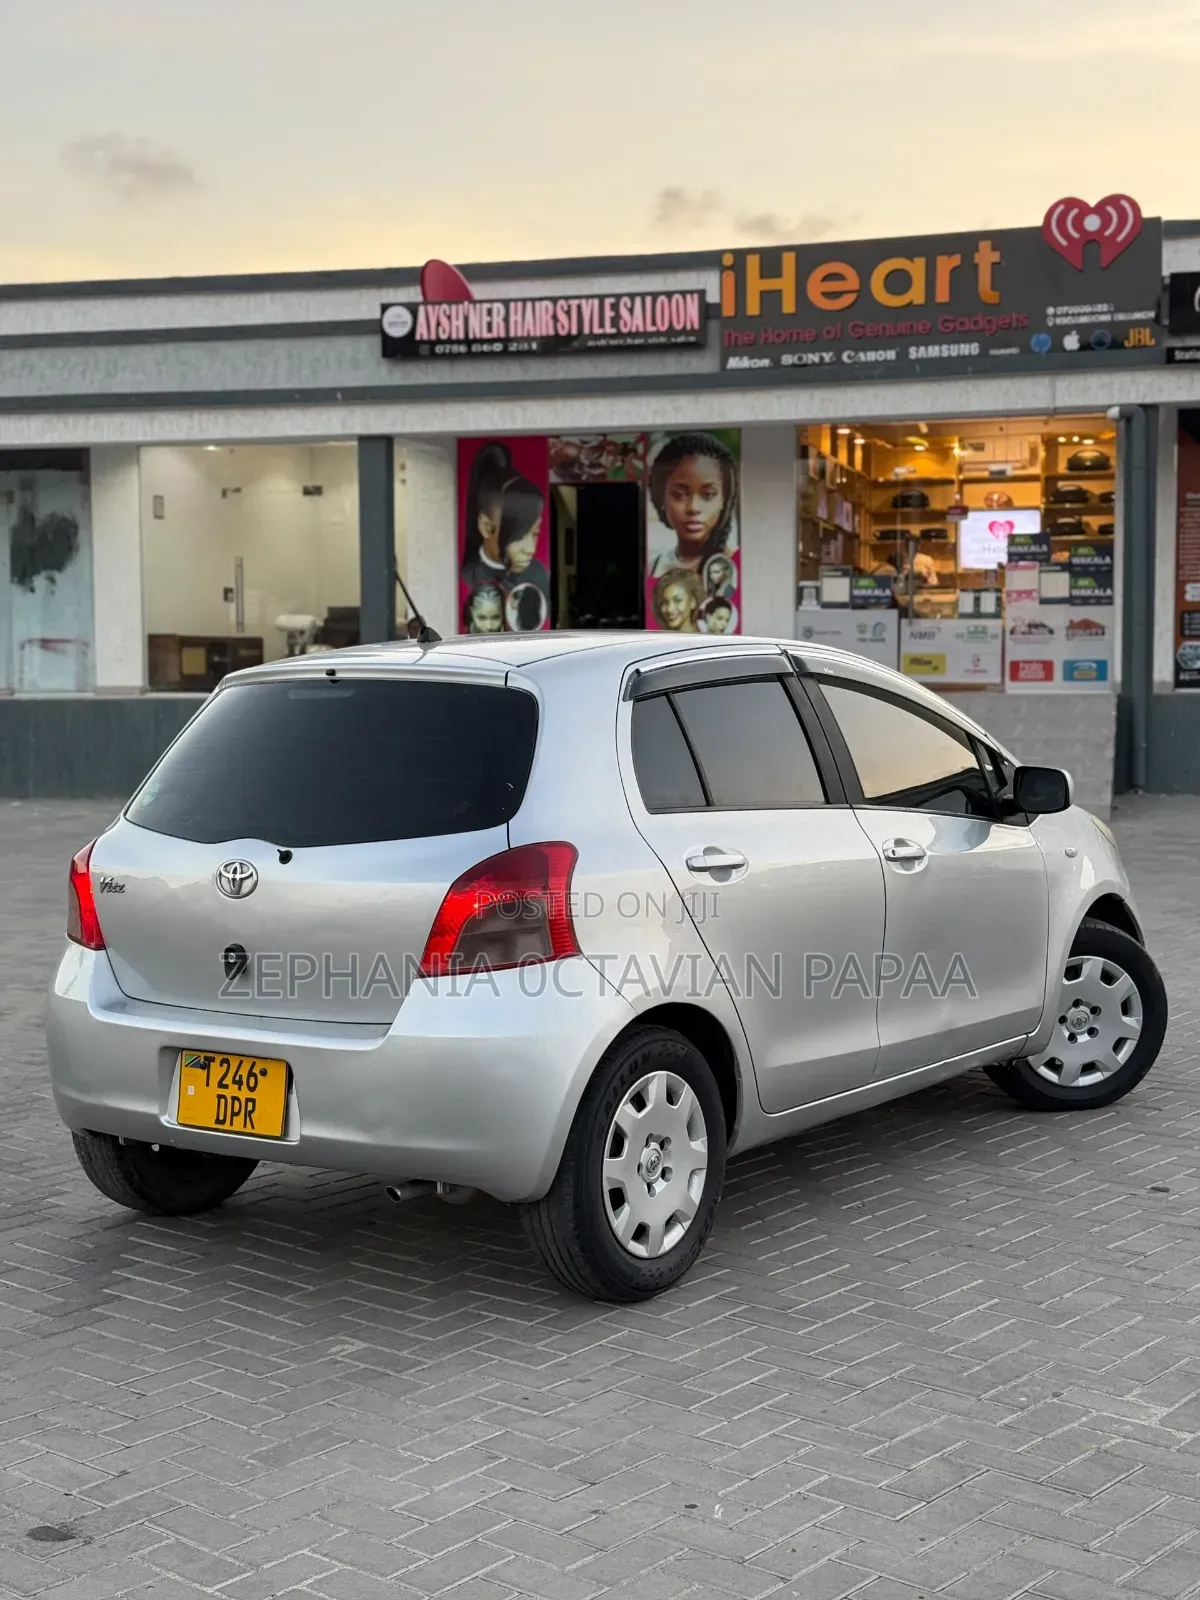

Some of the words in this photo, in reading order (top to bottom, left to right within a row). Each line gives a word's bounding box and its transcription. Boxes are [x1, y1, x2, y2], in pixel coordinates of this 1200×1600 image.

[722, 240, 1000, 317] iHeart
[415, 301, 506, 340] AYSH'NER
[509, 301, 555, 337] HAIR
[556, 298, 617, 336] STYLE
[619, 293, 699, 334] SALOON
[723, 329, 756, 348] The
[760, 327, 818, 344] Home
[849, 319, 931, 338] Genuine
[938, 312, 1029, 334] Gadgets
[1123, 327, 1156, 348] JBL
[780, 351, 834, 365] SONY
[908, 342, 980, 360] SAMSUNG
[726, 355, 771, 369] Nikon
[1071, 555, 1112, 565] WAKALA
[1071, 588, 1113, 597] WAKALA
[99, 876, 126, 894] Vitz
[214, 1094, 257, 1130] DPR
